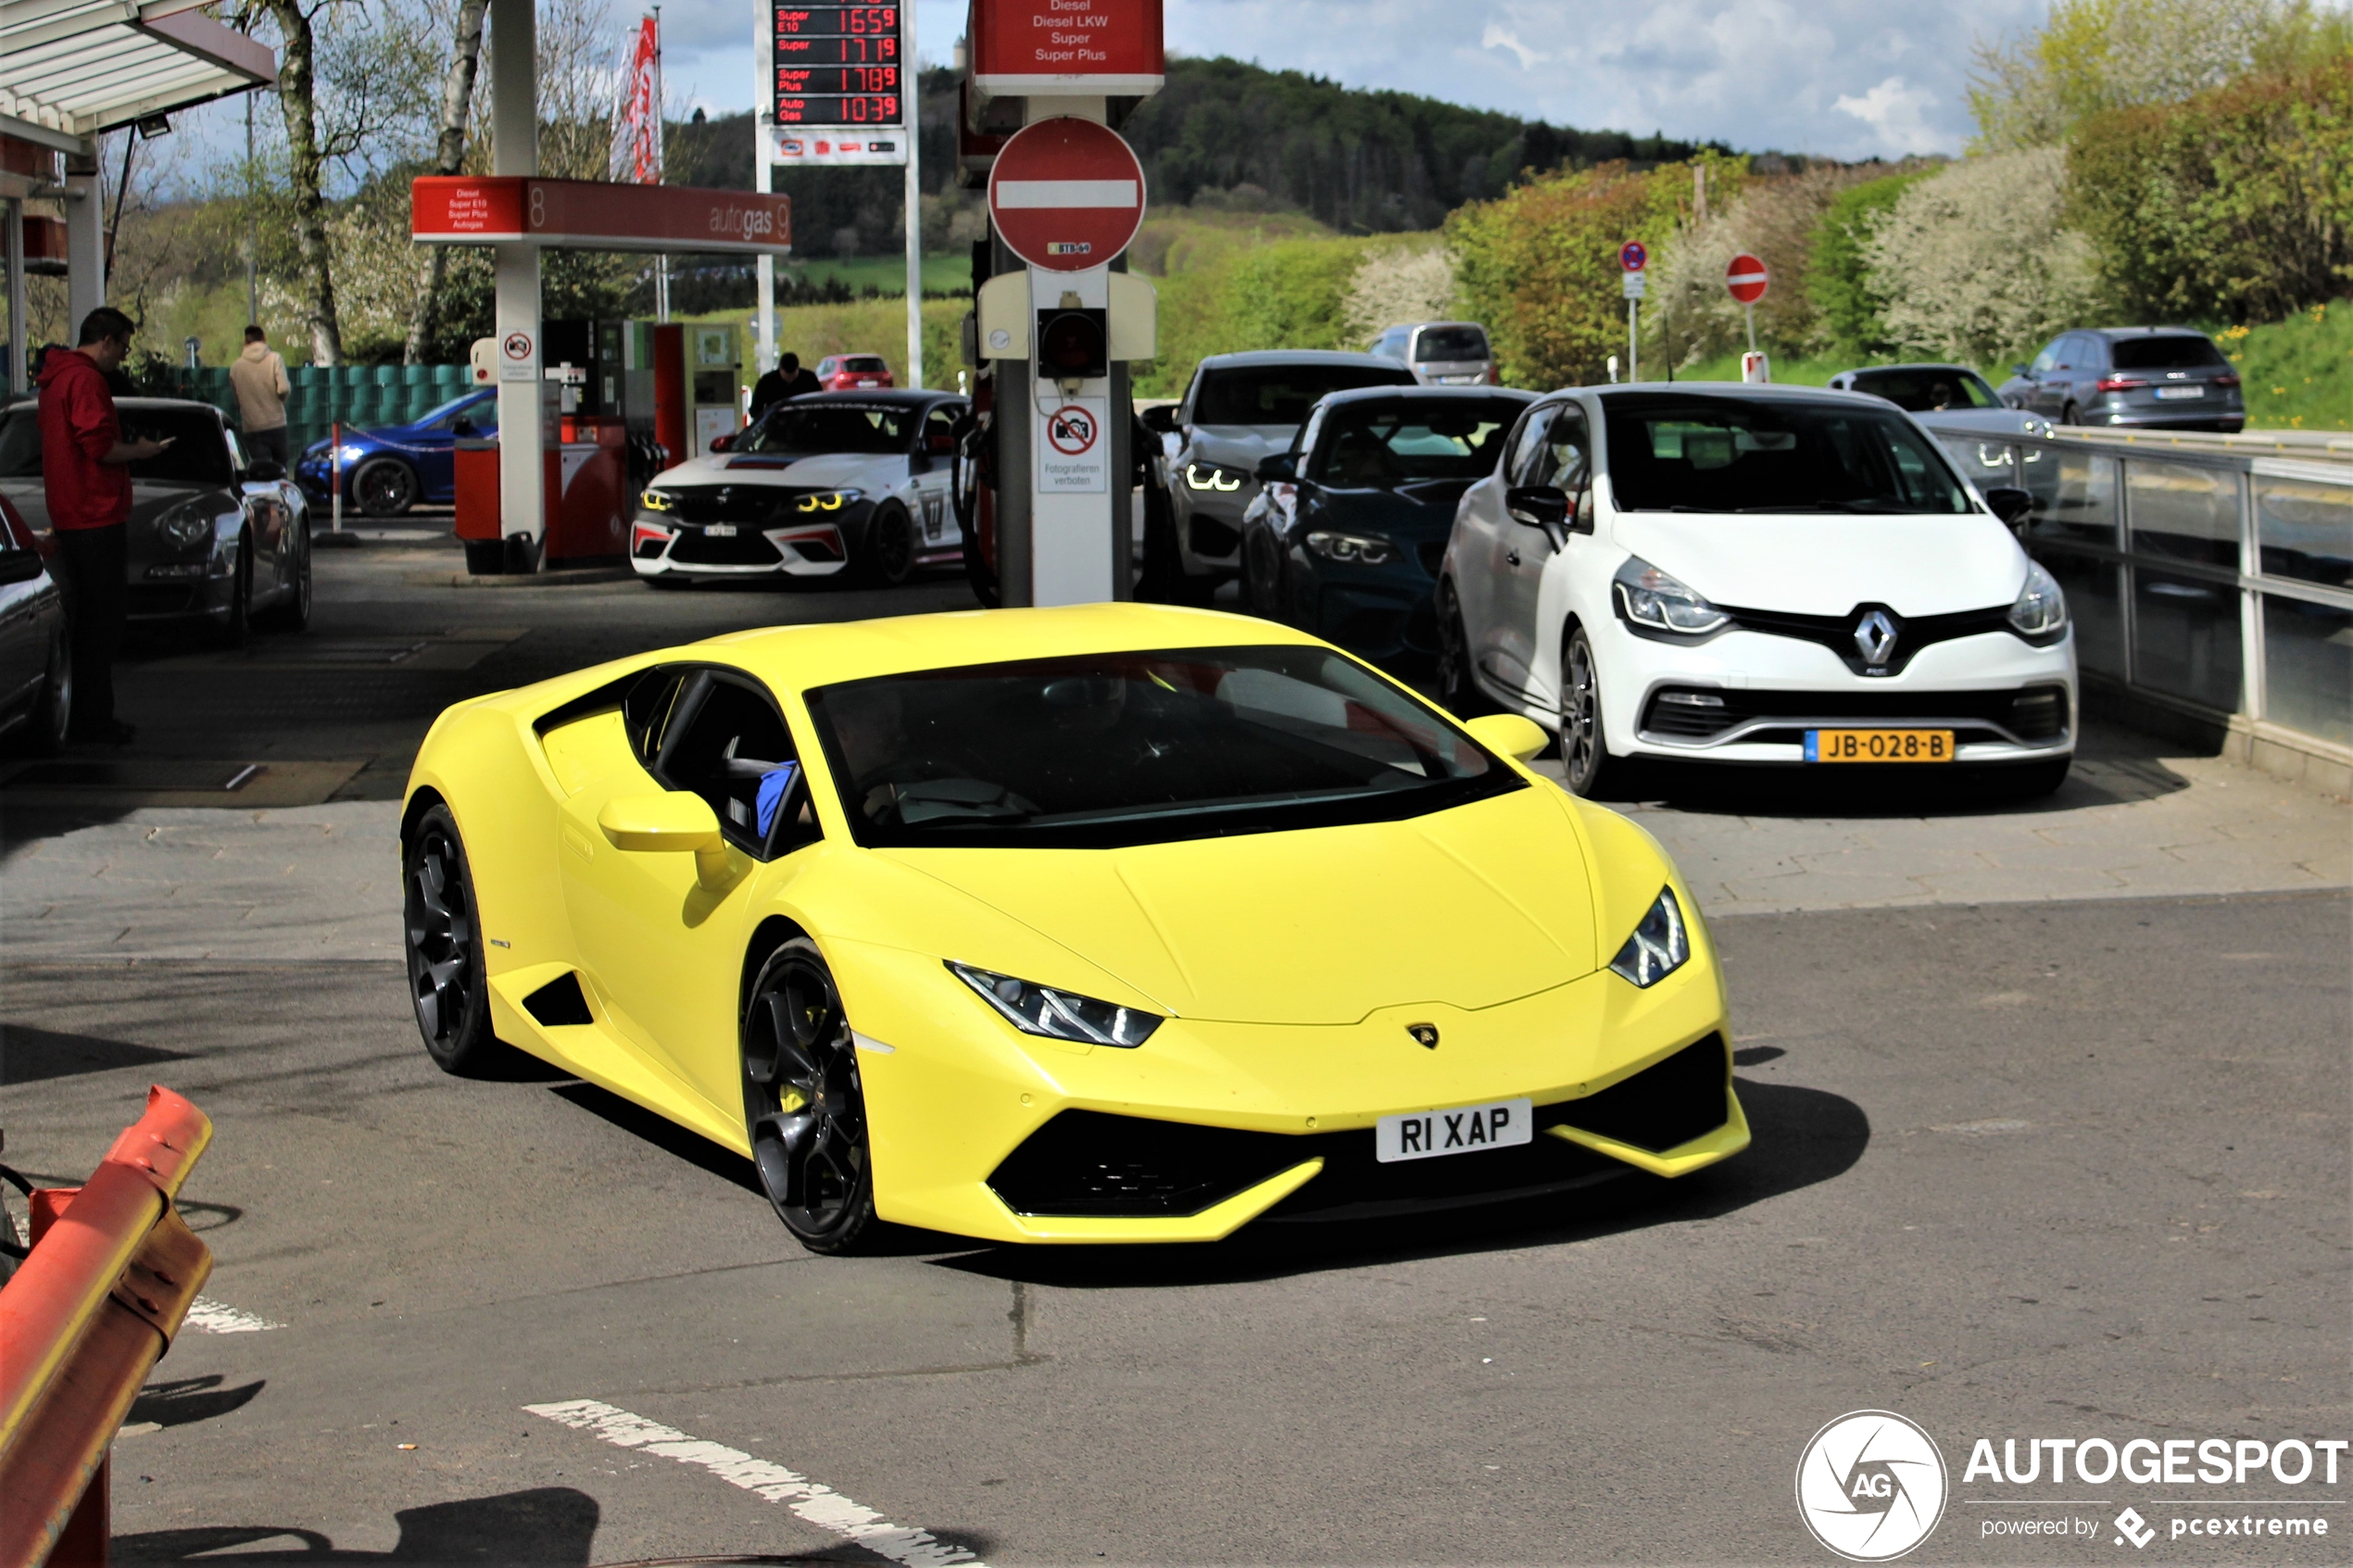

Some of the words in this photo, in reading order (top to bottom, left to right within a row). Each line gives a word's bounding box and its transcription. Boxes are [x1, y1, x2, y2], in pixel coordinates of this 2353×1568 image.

[1051, 0, 1090, 10] Diesel
[778, 10, 810, 21] Super
[1033, 16, 1073, 27] Diesel
[1077, 16, 1108, 27] LKW
[778, 22, 799, 32] E10
[1051, 32, 1090, 45] Super
[778, 40, 811, 51] Super
[1035, 49, 1074, 62] Super
[1078, 49, 1106, 60] Plus
[779, 69, 811, 81] Super
[779, 81, 802, 91] Plus
[779, 99, 805, 108] Auto
[780, 110, 801, 120] Gas
[457, 189, 479, 197] Diesel
[449, 199, 471, 208] Super
[472, 199, 487, 208] E10
[531, 187, 545, 228] 8
[448, 209, 470, 219] Super
[472, 209, 488, 219] Plus
[453, 220, 483, 230] Autogas
[709, 204, 773, 241] autogas
[777, 204, 788, 240] 9
[1045, 464, 1100, 474] Fotografieren
[1054, 476, 1090, 485] verboten
[1828, 734, 1944, 758] JB-028-B
[1443, 1108, 1510, 1148] XAP
